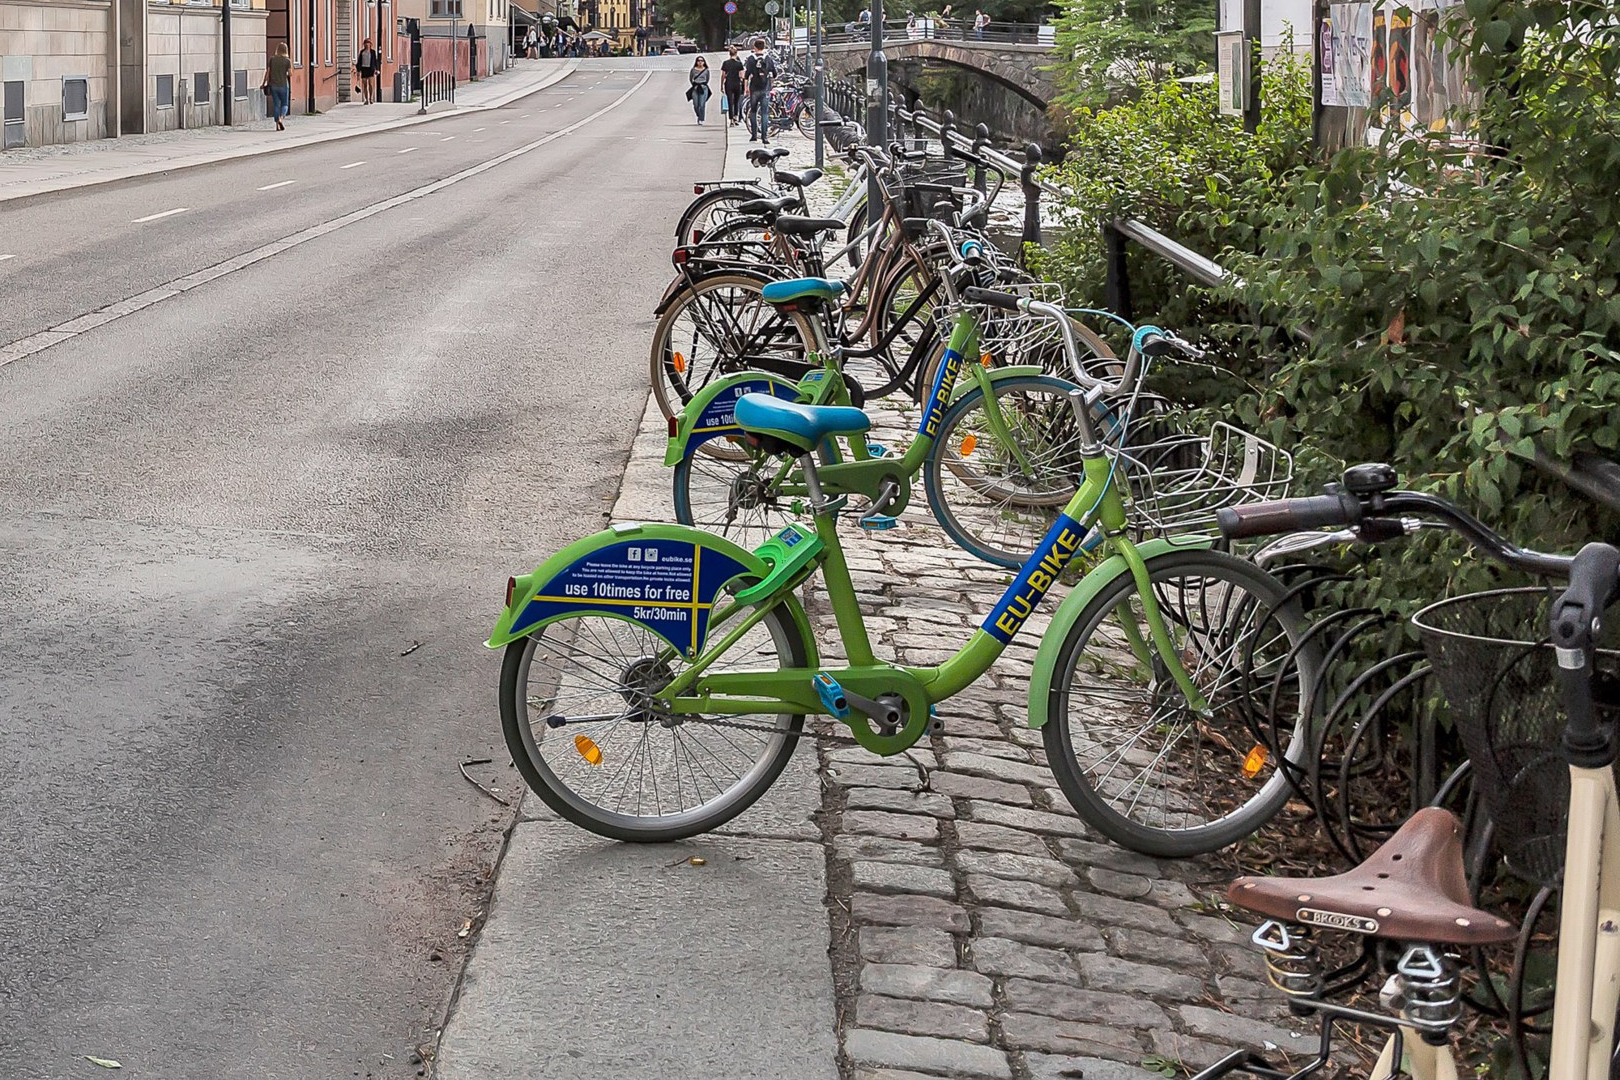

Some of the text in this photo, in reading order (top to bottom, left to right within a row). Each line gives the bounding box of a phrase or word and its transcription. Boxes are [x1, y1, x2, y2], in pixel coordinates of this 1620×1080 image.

[926, 358, 959, 436] EU-BIKE
[706, 414, 734, 426] use 10ti
[995, 528, 1082, 635] EU-BIKE
[566, 582, 689, 600] use 10times for free
[634, 607, 686, 621] 5kr/30min
[1314, 913, 1360, 928] BROOKS
